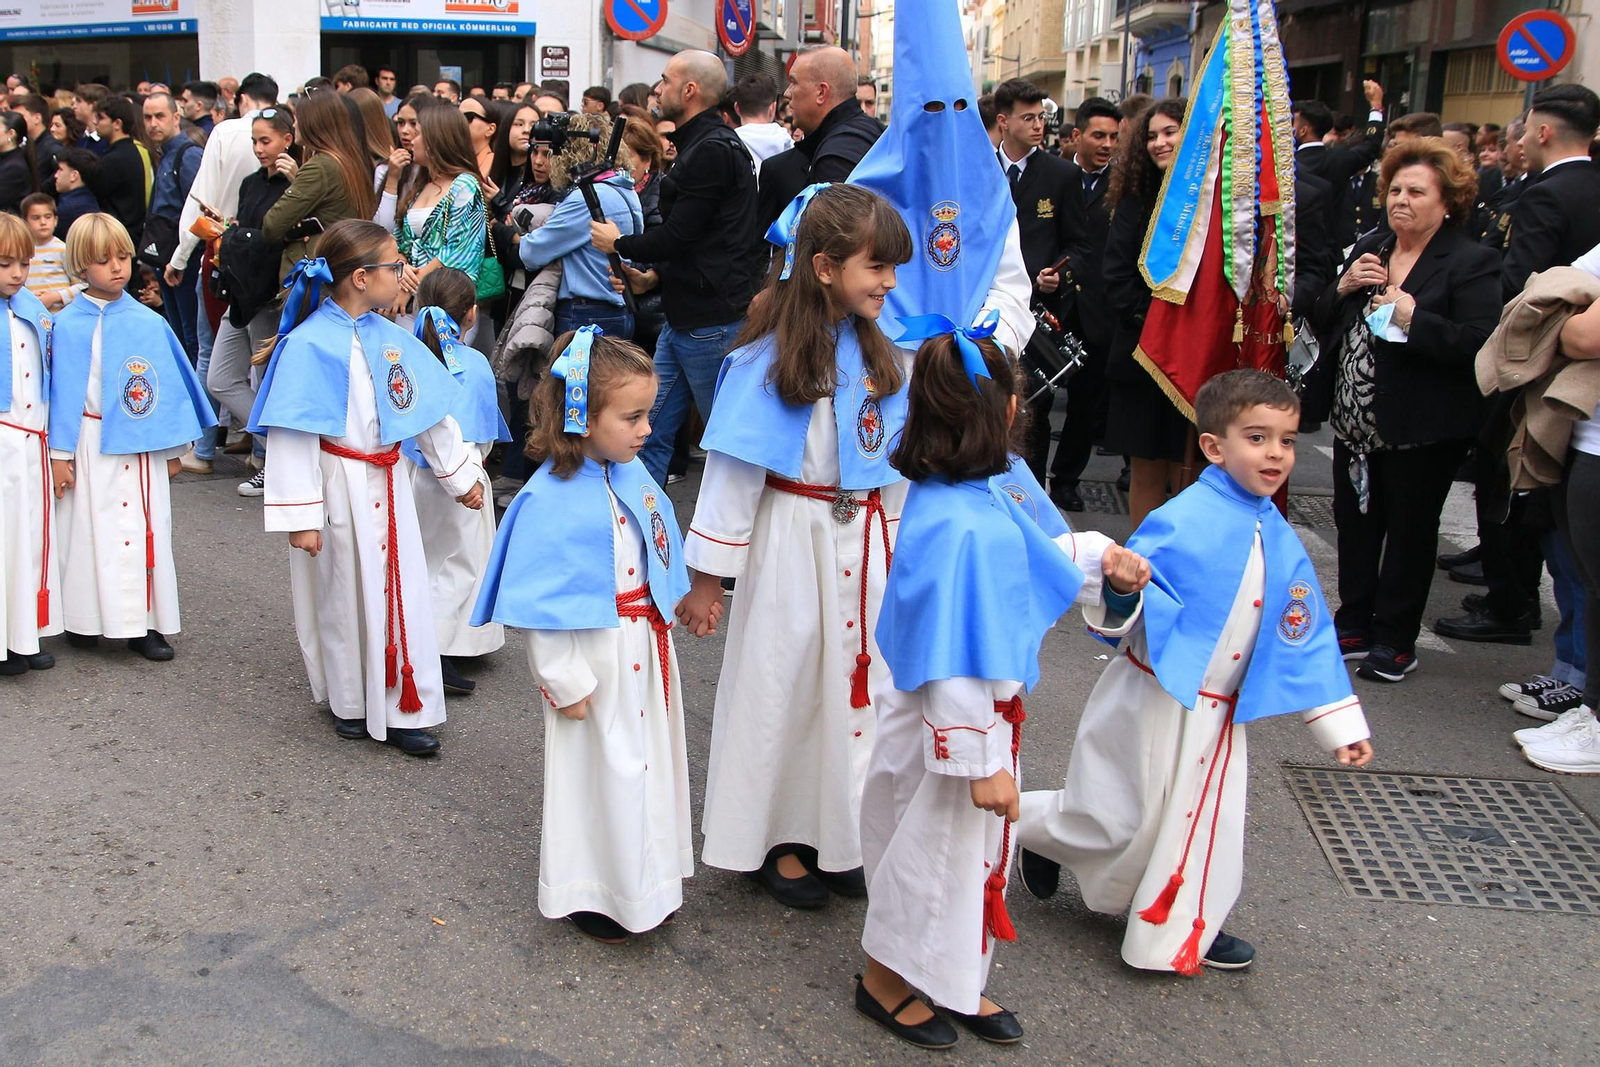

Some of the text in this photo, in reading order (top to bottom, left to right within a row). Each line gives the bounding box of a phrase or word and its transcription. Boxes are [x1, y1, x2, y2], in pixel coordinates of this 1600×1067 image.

[343, 20, 517, 32] FABRICANTE RED OFICIAL KÖMMERLING
[1509, 48, 1529, 56] AÑO
[1513, 57, 1540, 65] IMPAR
[1265, 46, 1285, 96] CIUDAD
[1274, 100, 1289, 117] DE
[1235, 107, 1250, 145] BANDAS
[1187, 182, 1198, 196] de
[437, 318, 462, 368] AMOR
[567, 346, 587, 427] AMOR
[1427, 842, 1523, 858] endesa
